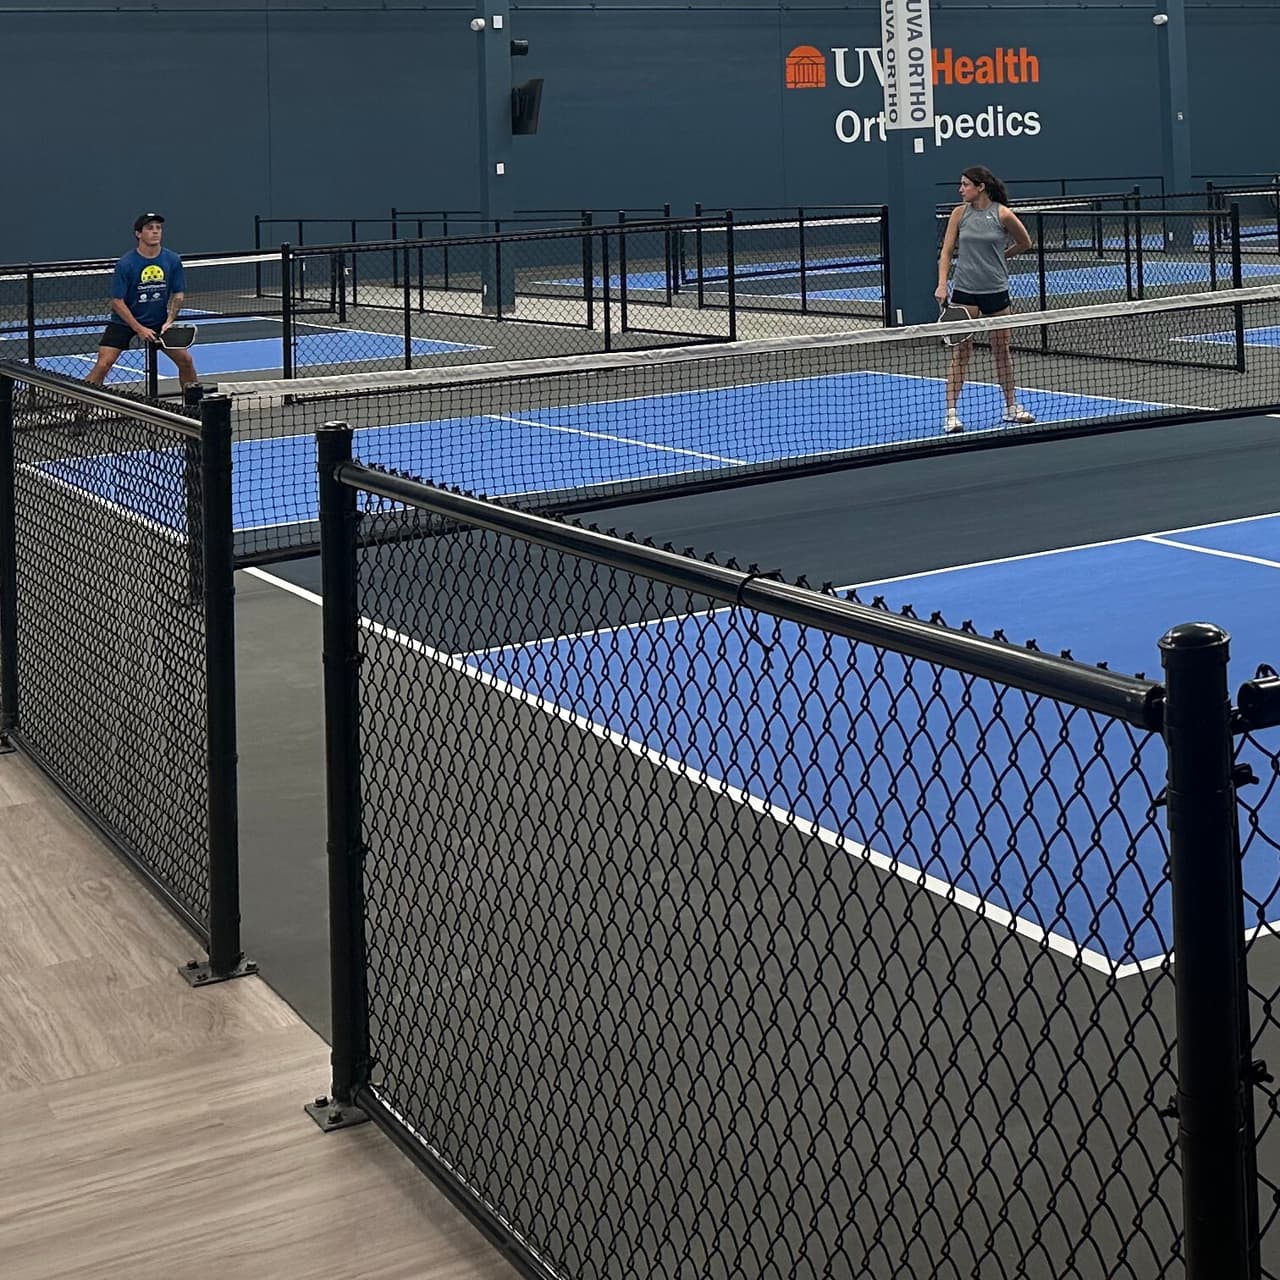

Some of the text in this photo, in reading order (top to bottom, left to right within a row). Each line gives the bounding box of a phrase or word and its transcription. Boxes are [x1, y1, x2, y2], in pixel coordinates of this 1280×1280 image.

[884, 0, 898, 123] UVA ORTHO
[908, 47, 926, 122] ORTHO
[931, 47, 1040, 85] Health
